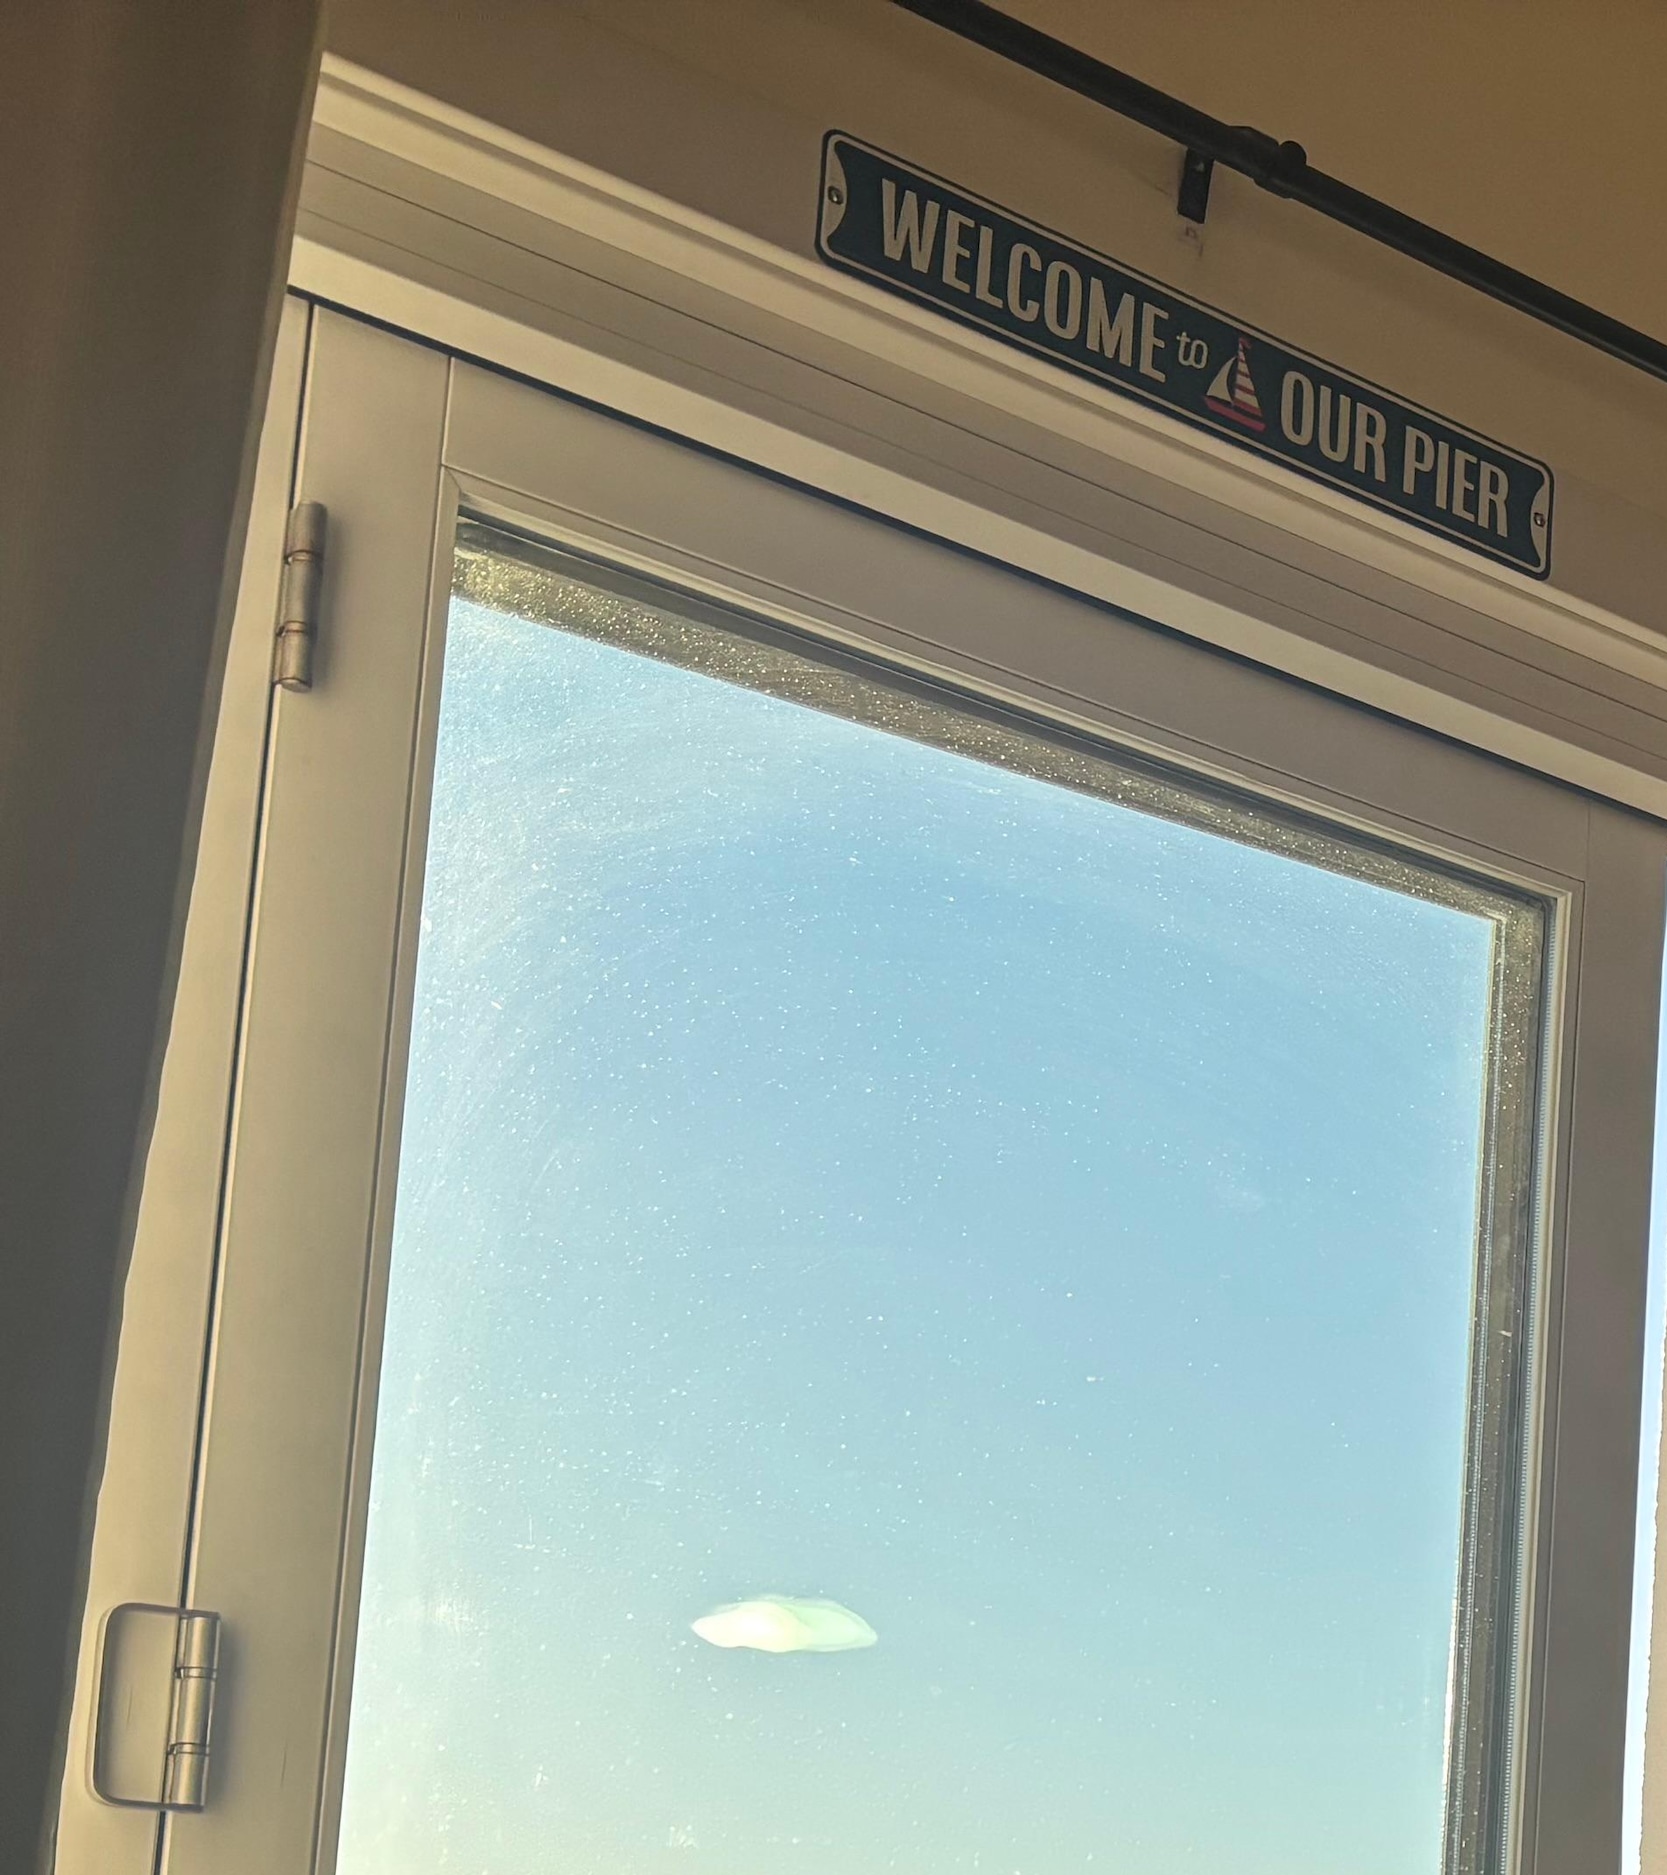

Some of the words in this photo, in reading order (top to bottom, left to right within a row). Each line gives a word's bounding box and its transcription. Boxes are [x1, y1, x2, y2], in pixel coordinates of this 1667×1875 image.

[881, 178, 1169, 382] WELCOME
[1176, 329, 1208, 369] to
[1280, 369, 1386, 482] OUR
[1404, 423, 1511, 537] PIER
